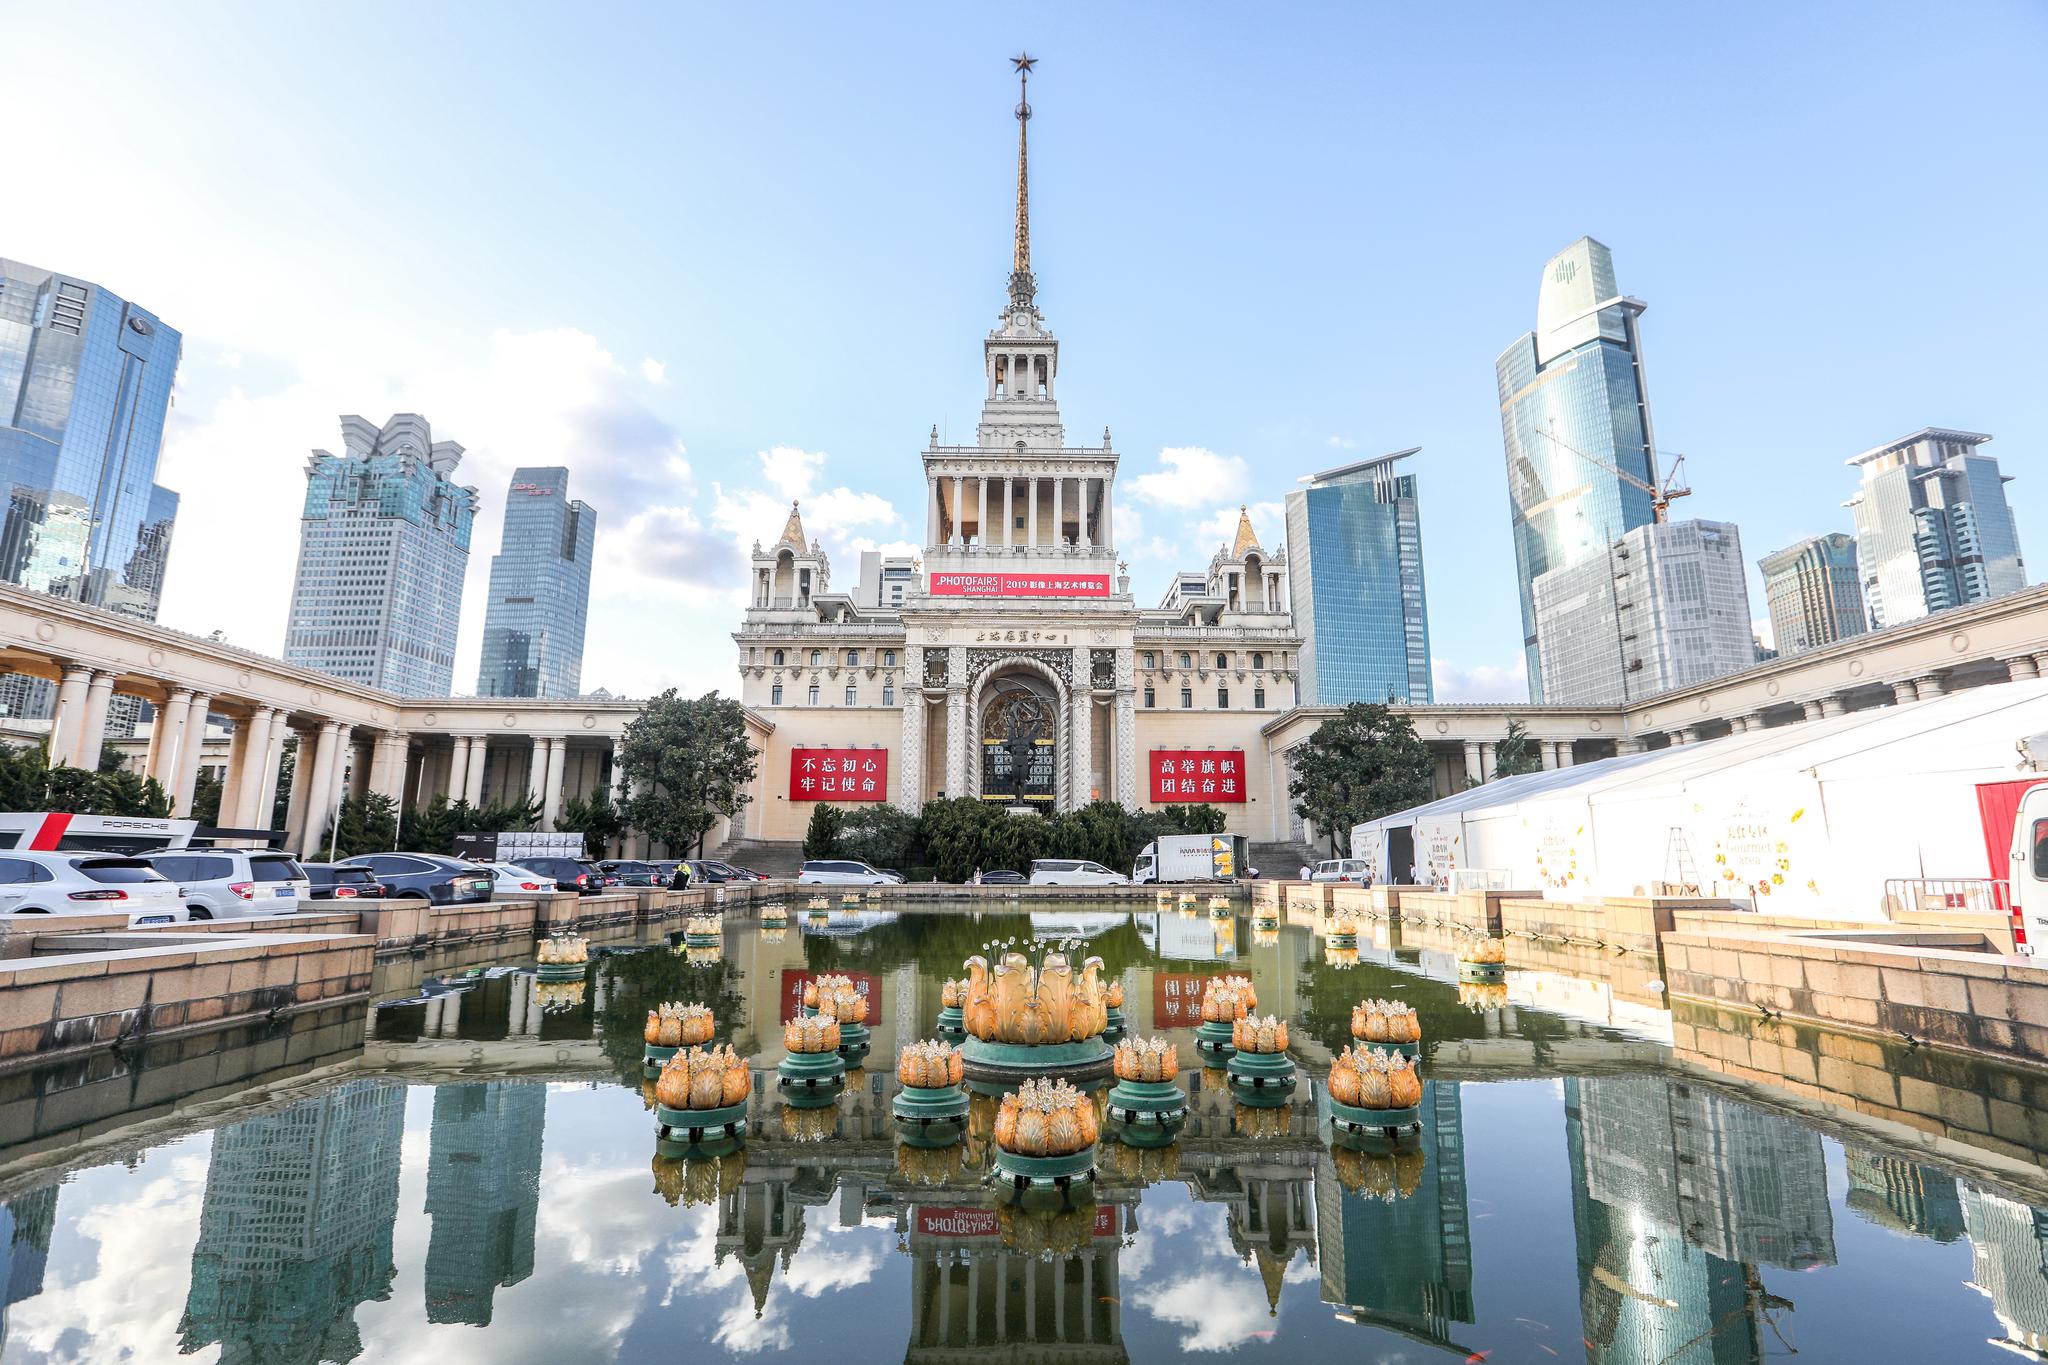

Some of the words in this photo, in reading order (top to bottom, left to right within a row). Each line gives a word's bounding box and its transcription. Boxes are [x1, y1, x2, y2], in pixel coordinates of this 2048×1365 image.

[939, 576, 998, 586] PHOTOFAIRS
[1006, 580, 1028, 589] 2019
[1029, 581, 1103, 590] 影像上海艺术博览会
[962, 585, 998, 593] SHANGHAI
[801, 757, 877, 773] 不忘初心
[1160, 759, 1236, 774] 高举旗帜
[800, 777, 876, 793] 牢记使命
[1161, 778, 1236, 794] 团结奋进
[102, 820, 169, 831] PORSCHE
